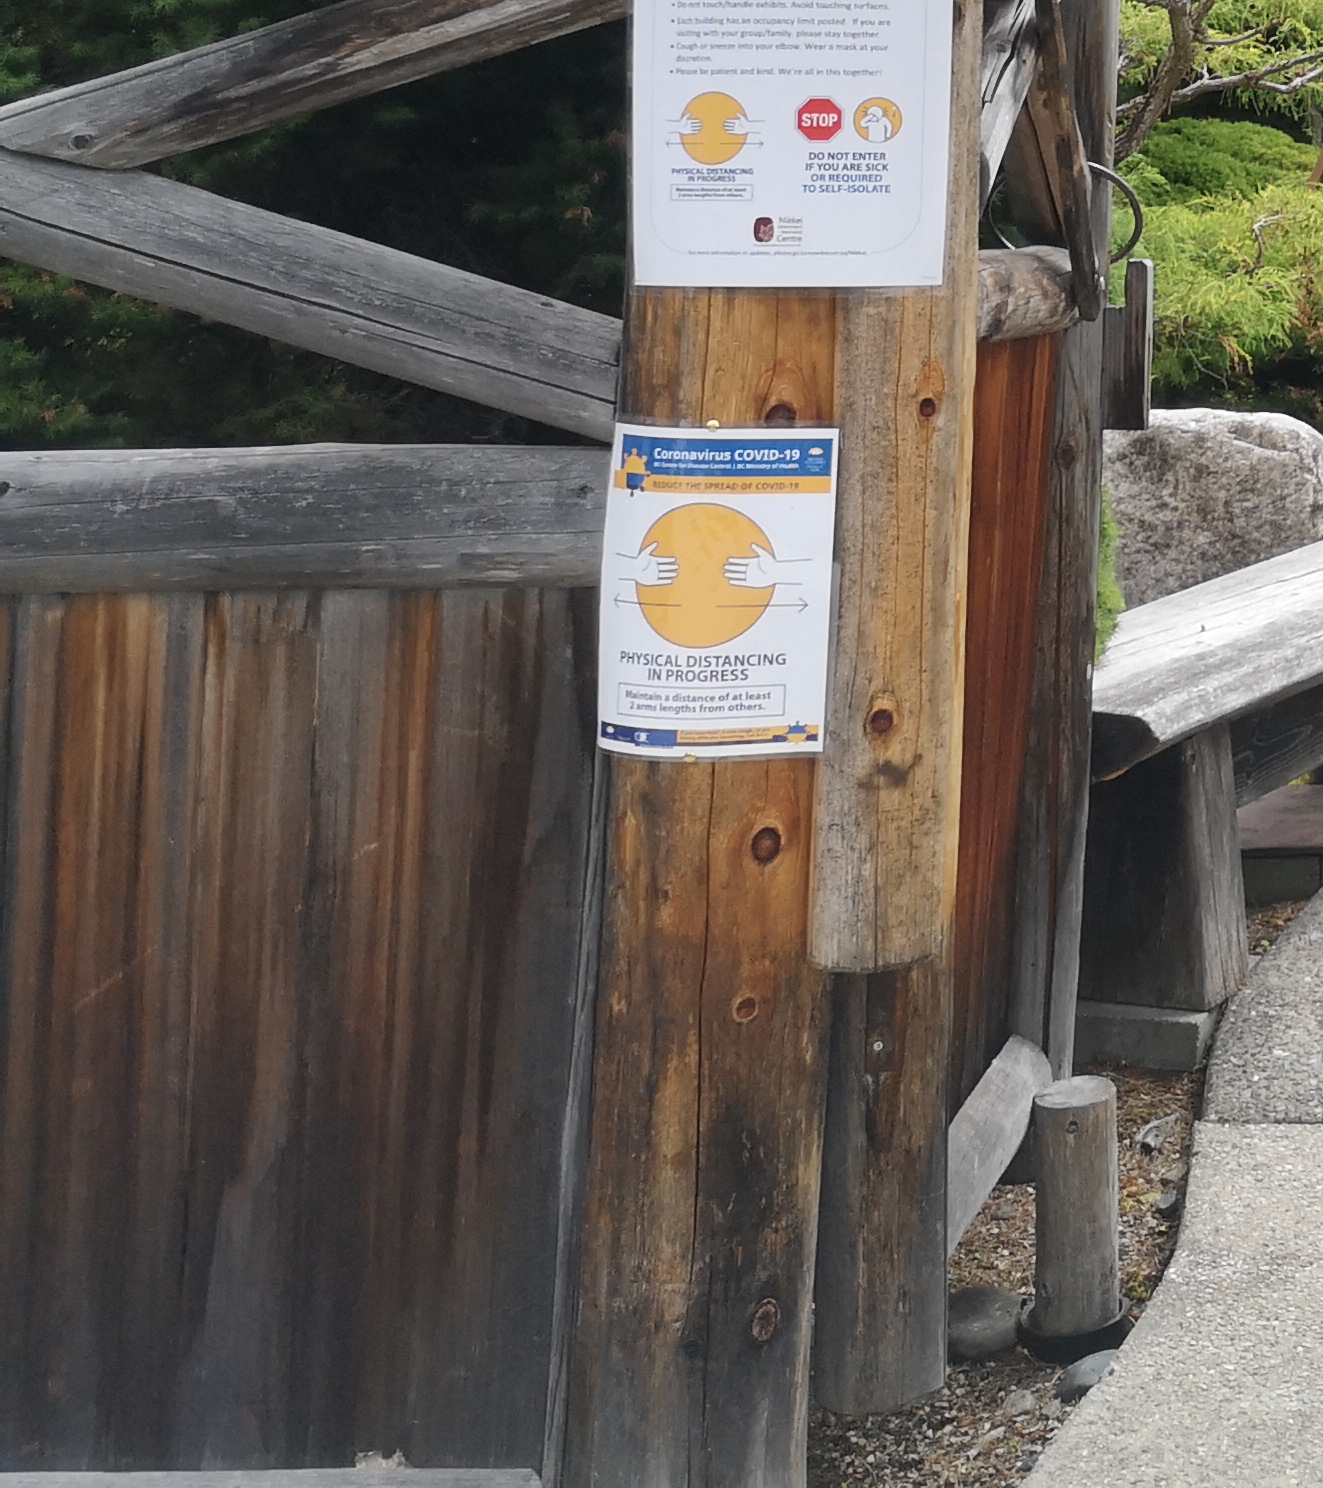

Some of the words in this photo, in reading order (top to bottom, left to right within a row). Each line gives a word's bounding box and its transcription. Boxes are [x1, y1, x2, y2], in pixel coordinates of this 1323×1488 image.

[801, 113, 838, 127] STOP
[808, 152, 824, 160] DO
[828, 152, 850, 161] NOT
[852, 152, 886, 161] ENTER
[805, 163, 814, 171] IF
[818, 163, 839, 171] YOU
[842, 163, 863, 171] ARE
[865, 163, 888, 172] SICK
[811, 174, 825, 182] OR
[828, 174, 882, 182] REQUIRED
[802, 184, 816, 193] TO
[819, 185, 891, 193] SELF-ISOLATE
[654, 448, 731, 461] Coronavirus
[734, 449, 800, 461] COVID-19
[620, 651, 681, 667] PHYSICAL
[686, 653, 787, 668] DISTANCING
[648, 668, 661, 681] IN
[666, 669, 749, 682] PROGRESS
[625, 690, 662, 701] Maintain
[672, 694, 715, 702] distance
[719, 693, 729, 701] of
[745, 692, 771, 700] least
[630, 701, 635, 709] 2
[659, 703, 696, 714] lengths
[699, 703, 725, 712] from
[728, 702, 765, 711] others.
